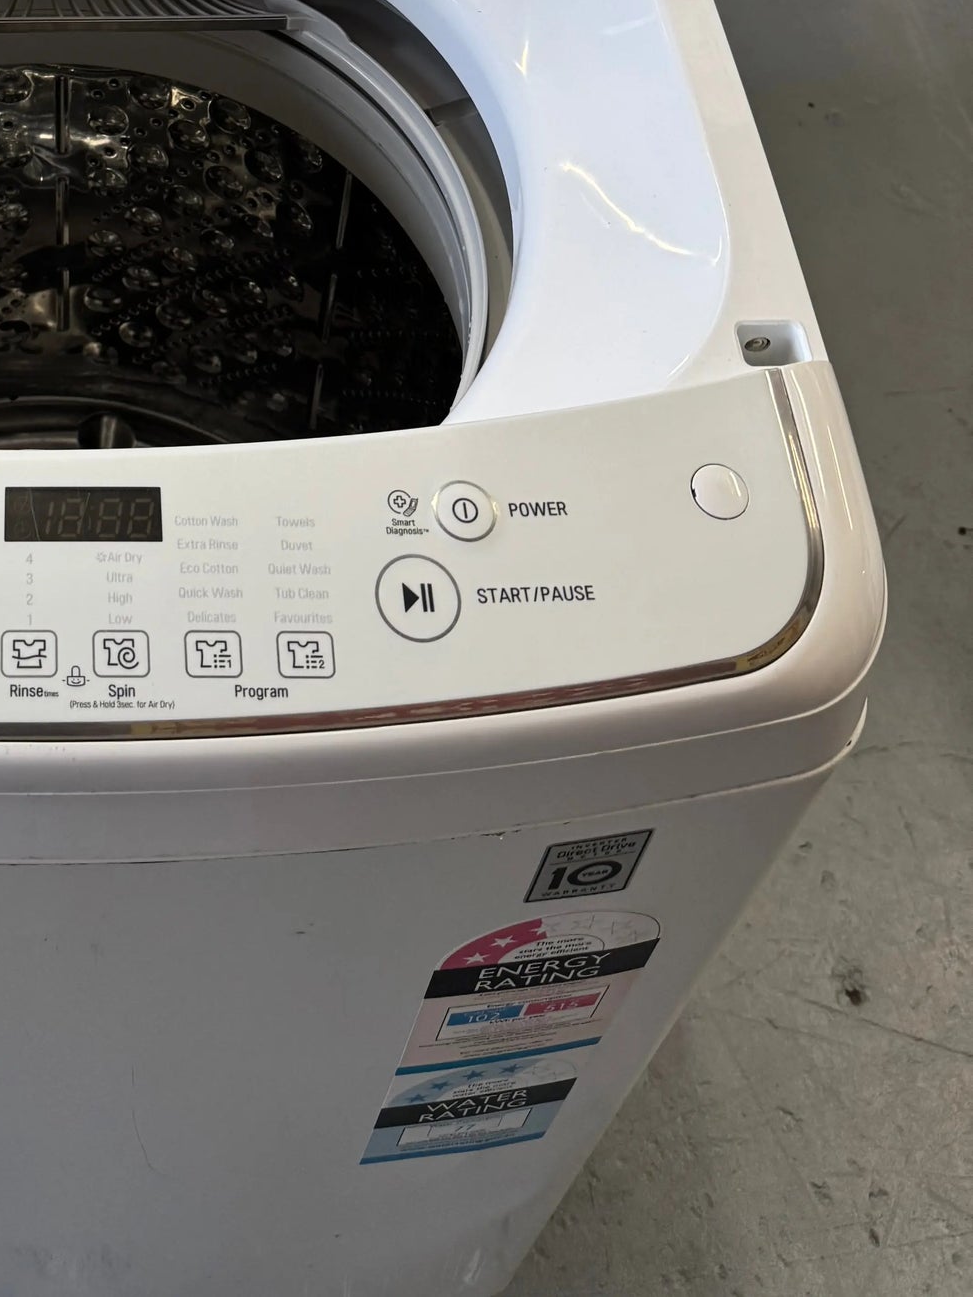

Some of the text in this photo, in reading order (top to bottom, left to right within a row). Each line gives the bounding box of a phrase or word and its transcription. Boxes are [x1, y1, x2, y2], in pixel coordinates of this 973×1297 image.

[508, 502, 568, 517] POWER
[175, 516, 238, 527] Cotton Wash
[276, 516, 315, 528] Towels
[177, 539, 238, 550] Extra Rinse
[281, 540, 313, 551] Duvet
[26, 554, 33, 564] 4
[108, 552, 142, 565] Air Dry
[180, 563, 238, 574] Eco Cotton
[268, 564, 331, 575] Quiet Wash
[26, 574, 33, 584] 3
[107, 572, 133, 583] Ultra
[108, 592, 133, 605] High
[179, 587, 243, 599] Quick Wash
[276, 588, 329, 599] Tub Clean
[477, 585, 596, 604] START/PAUSE
[26, 594, 33, 605] 2
[108, 614, 133, 624] Low
[187, 611, 236, 623] Delicates
[274, 612, 333, 624] Favourites
[10, 684, 44, 697] Rinse
[108, 684, 136, 700] Spin
[235, 685, 288, 700] Program
[70, 701, 91, 709] (Press
[160, 701, 175, 710] Dry)
[557, 842, 636, 859] Direct Drive
[582, 869, 609, 877] YEAR
[478, 952, 611, 980] ENERGY
[474, 966, 600, 992] RATING
[427, 1089, 527, 1112] WATER
[418, 1099, 527, 1123] RATING
